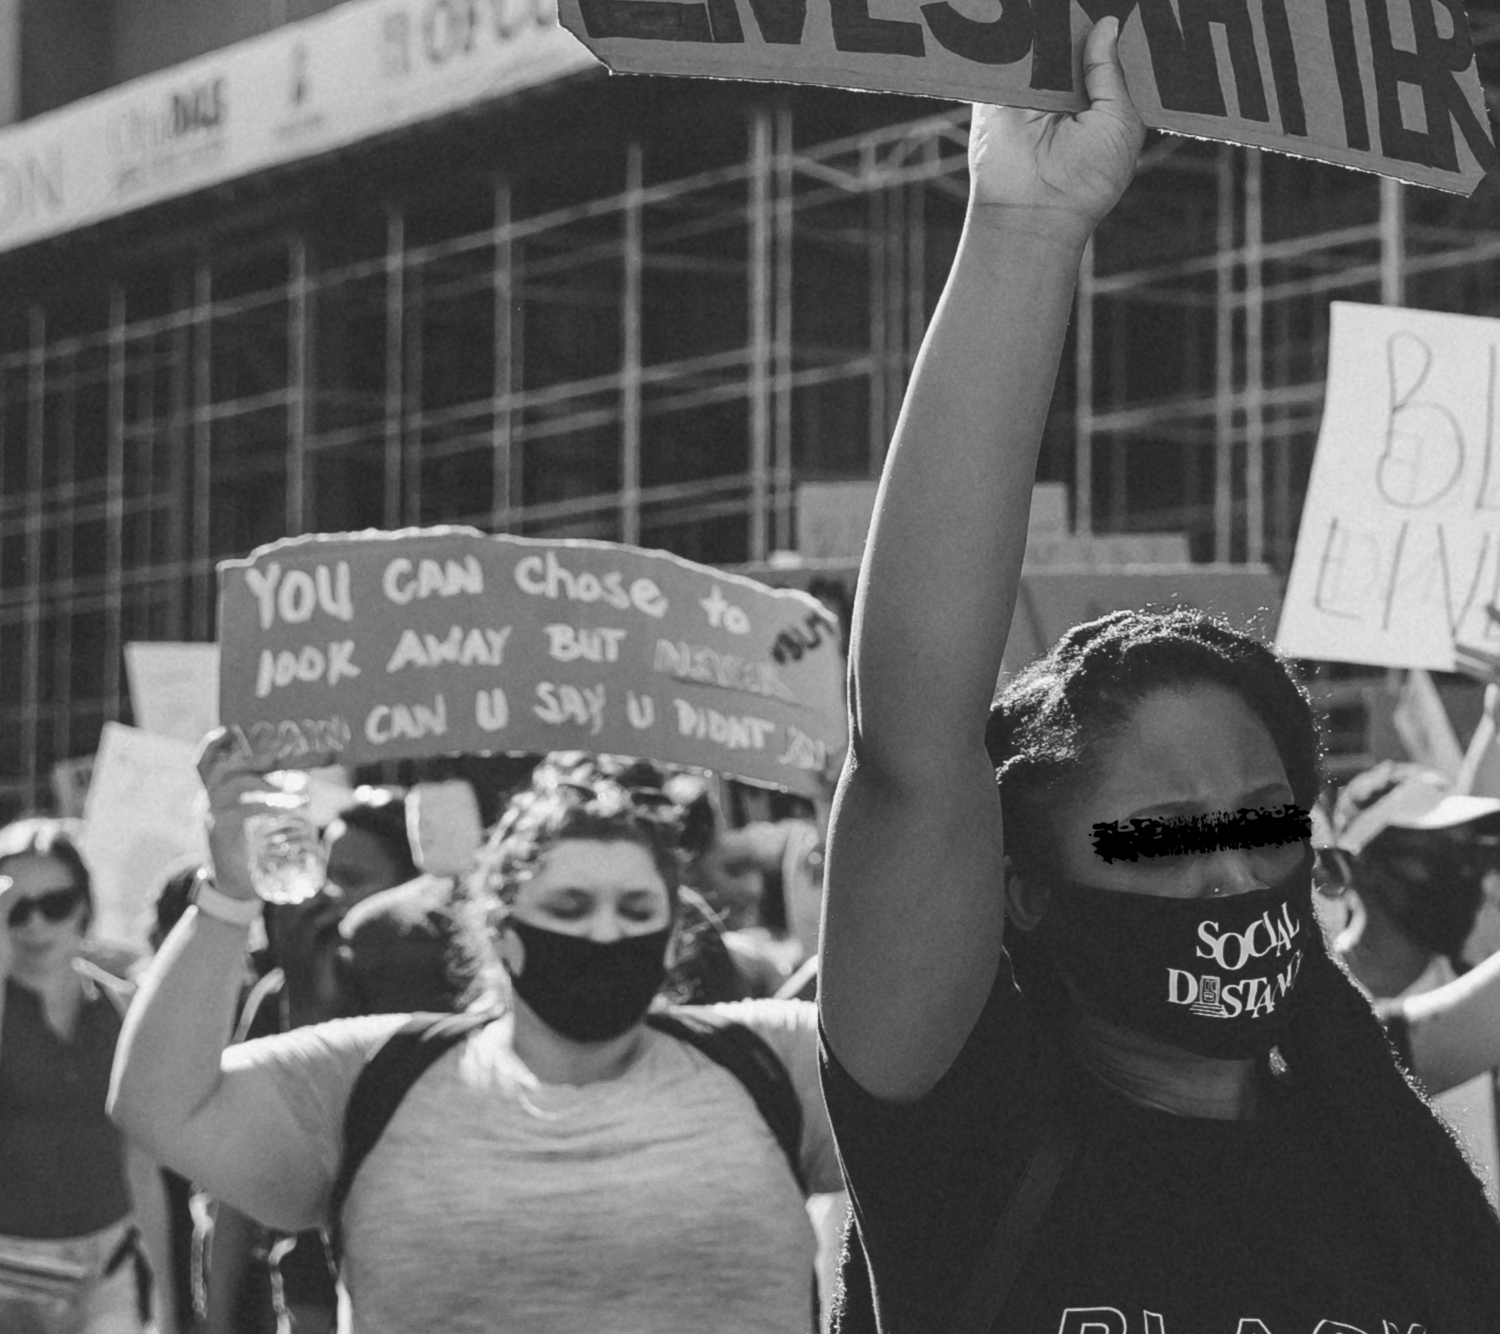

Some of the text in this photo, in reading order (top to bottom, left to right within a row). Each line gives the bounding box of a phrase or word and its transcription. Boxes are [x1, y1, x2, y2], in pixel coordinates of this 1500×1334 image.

[244, 561, 354, 630] YOU
[381, 554, 485, 605] CAN
[701, 584, 751, 635] to
[385, 624, 514, 673] AWAY
[544, 622, 628, 661] BUT
[364, 692, 448, 746] CAN
[473, 687, 509, 731] U
[532, 680, 607, 737] SAY
[625, 691, 656, 730] U
[673, 698, 777, 751] DIDNT
[1196, 901, 1300, 971] SOCIAL
